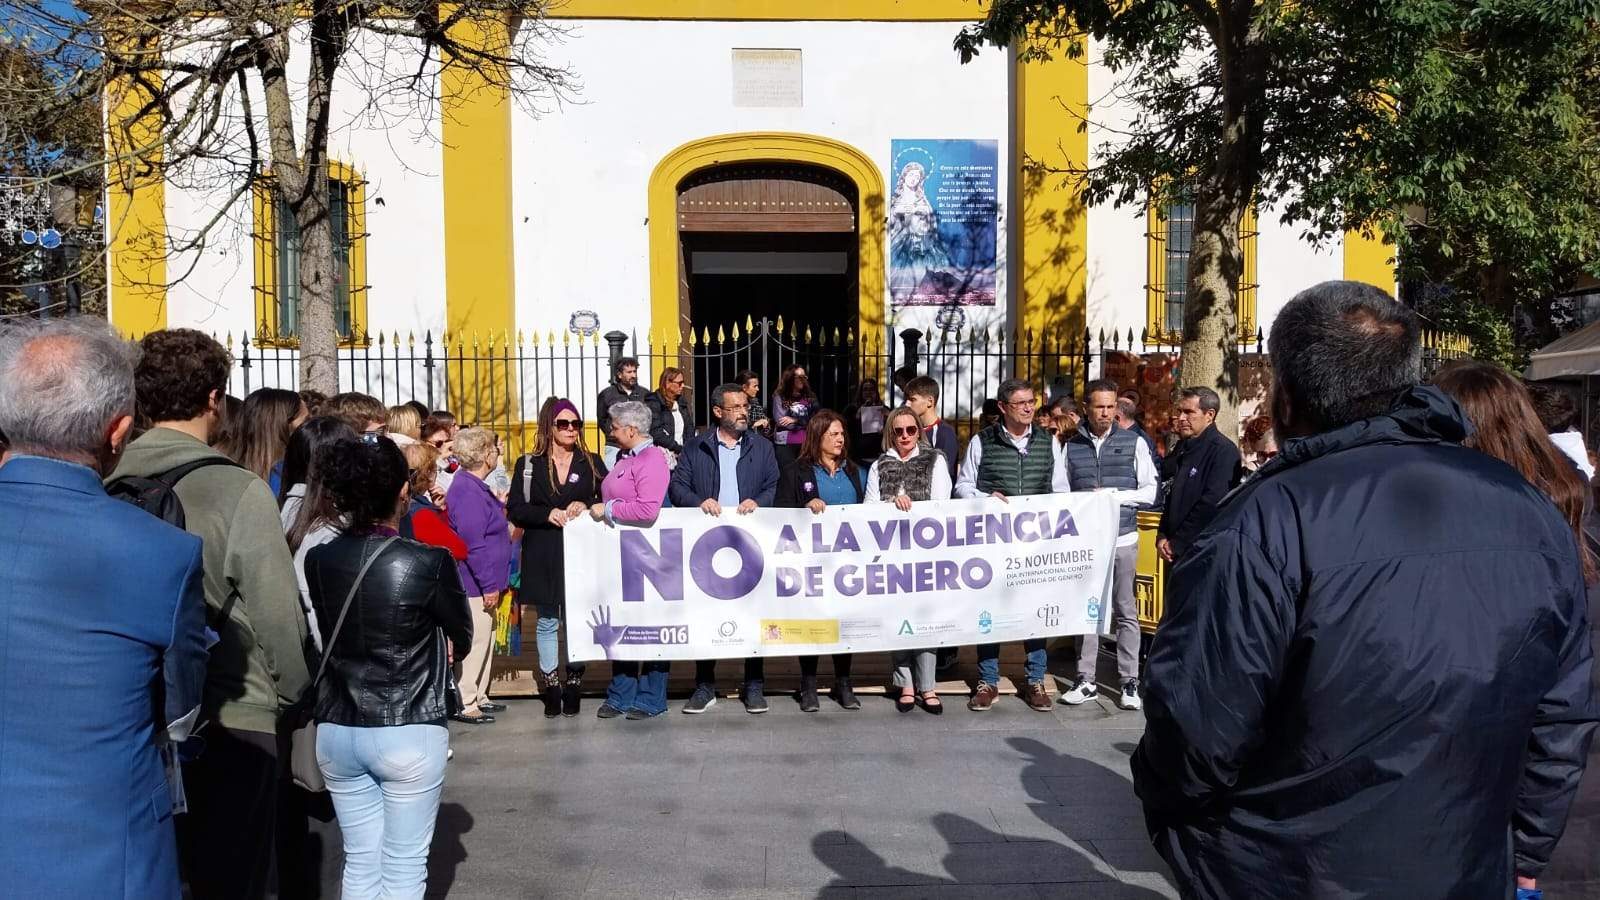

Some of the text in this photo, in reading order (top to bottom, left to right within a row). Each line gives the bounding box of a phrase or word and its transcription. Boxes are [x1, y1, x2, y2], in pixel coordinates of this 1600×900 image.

[773, 509, 1079, 554] A LA VIOLENCIA
[620, 525, 764, 602] NO
[1004, 548, 1095, 571] 25 NOVIEMBRE
[1019, 567, 1066, 578] INTERNACIONAL
[1067, 564, 1092, 573] CONTRA
[775, 555, 993, 599] DE GÉNERO
[1006, 580, 1015, 588] LA
[1015, 577, 1047, 587] VIOLENCIA
[659, 626, 688, 645] 016
